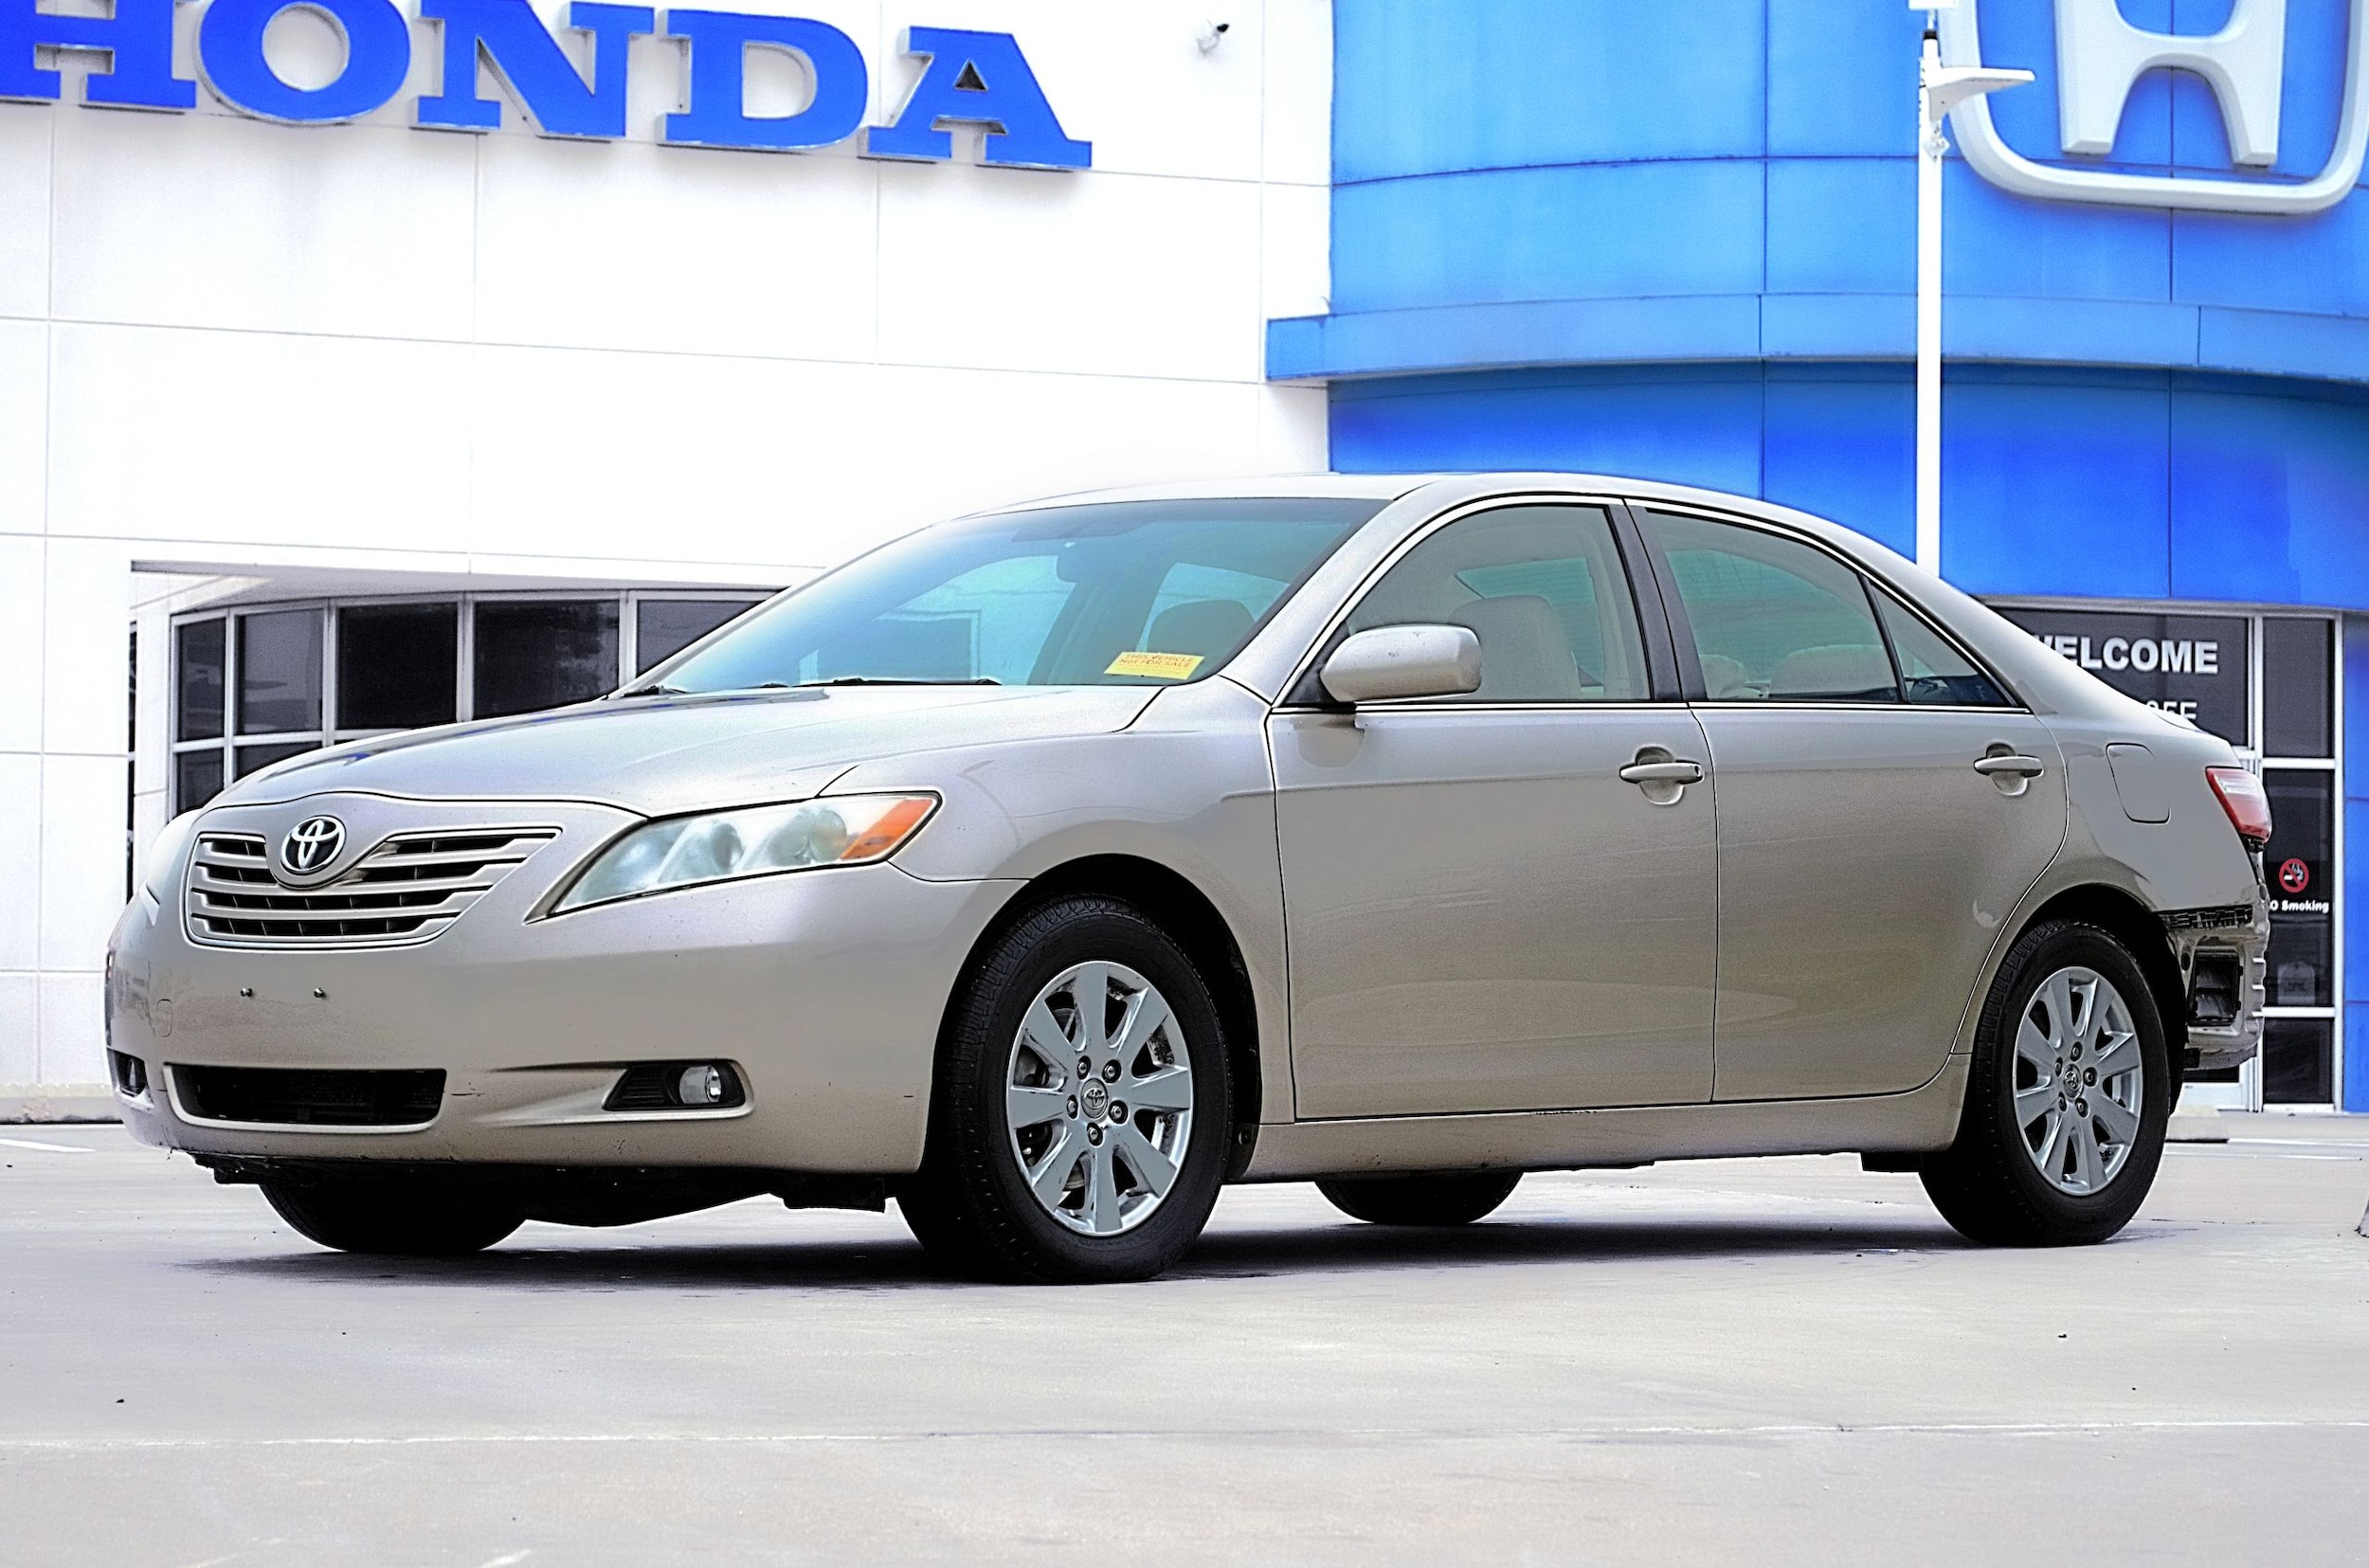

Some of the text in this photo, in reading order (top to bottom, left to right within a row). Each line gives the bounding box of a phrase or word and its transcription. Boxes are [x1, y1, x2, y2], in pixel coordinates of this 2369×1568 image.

[0, 0, 1092, 168] HONDA
[2033, 635, 2219, 674] ELCOME
[2281, 899, 2330, 914] Smoking
